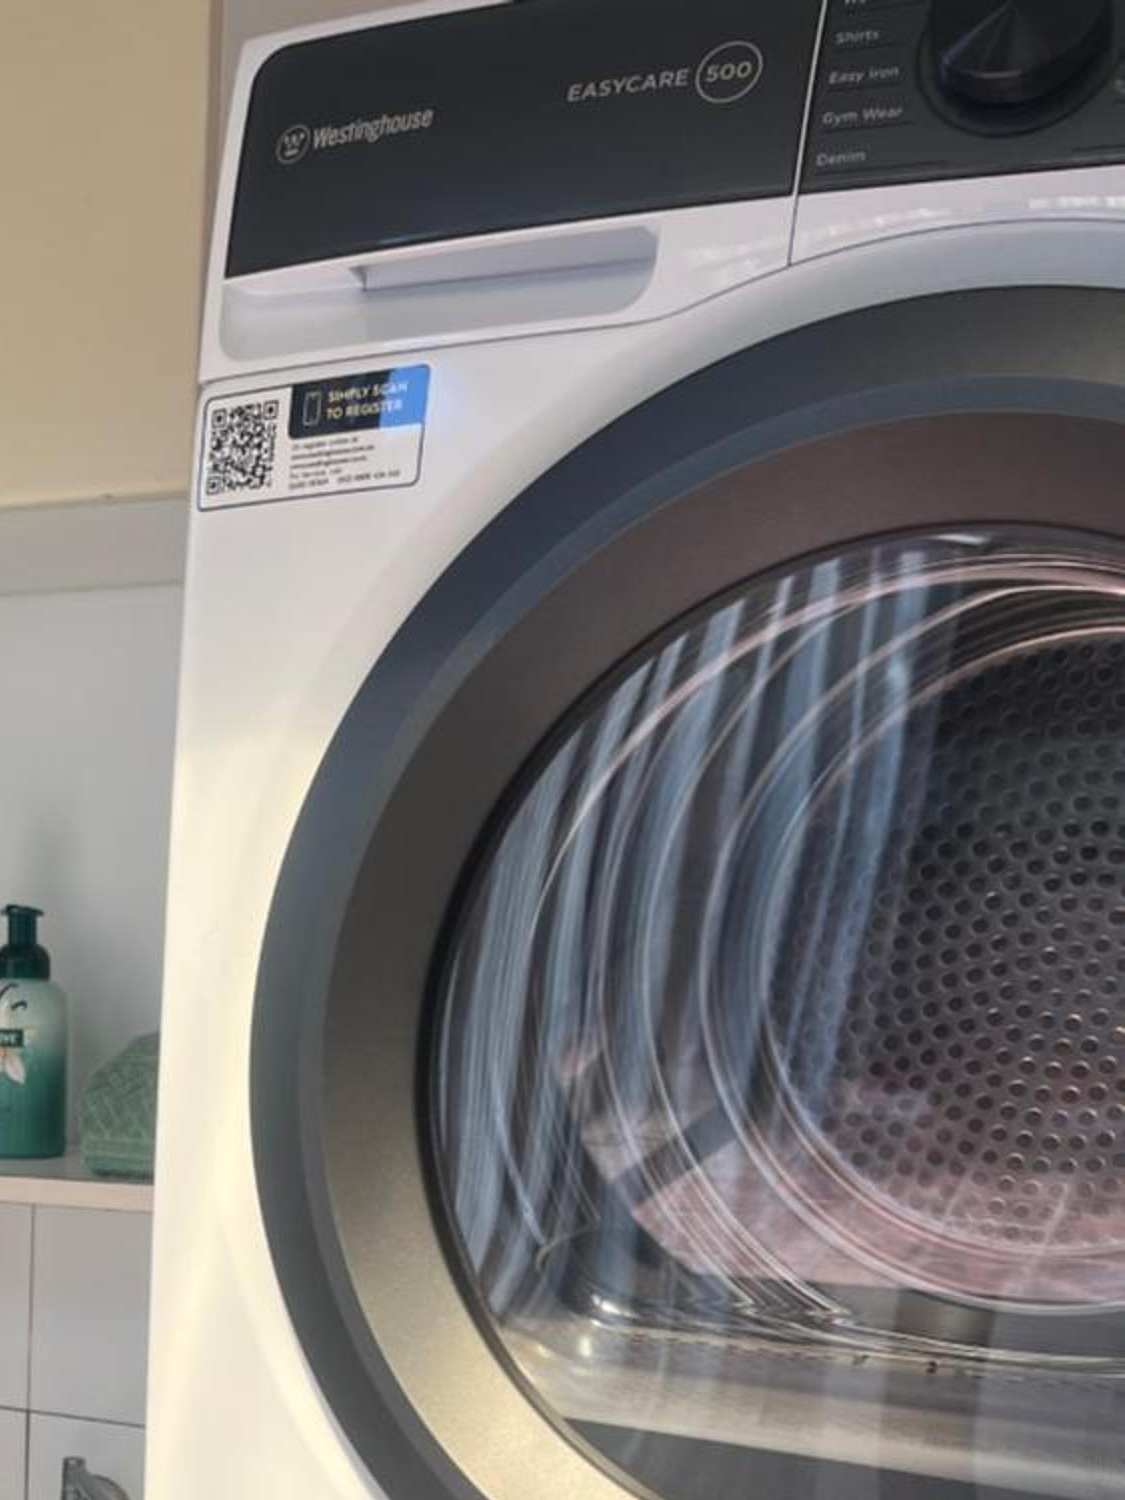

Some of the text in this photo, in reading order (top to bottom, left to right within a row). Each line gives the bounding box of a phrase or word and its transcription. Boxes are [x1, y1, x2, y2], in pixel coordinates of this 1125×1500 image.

[835, 29, 879, 44] Shirts
[567, 61, 752, 102] EASYCARE 500
[829, 66, 900, 86] Easy Iron
[823, 106, 904, 126] Gym Wear
[312, 107, 435, 151] Westinghouse
[816, 151, 866, 167] Denim
[328, 382, 409, 402] SIMPLY SCAN
[326, 399, 404, 420] TO REGISTER
